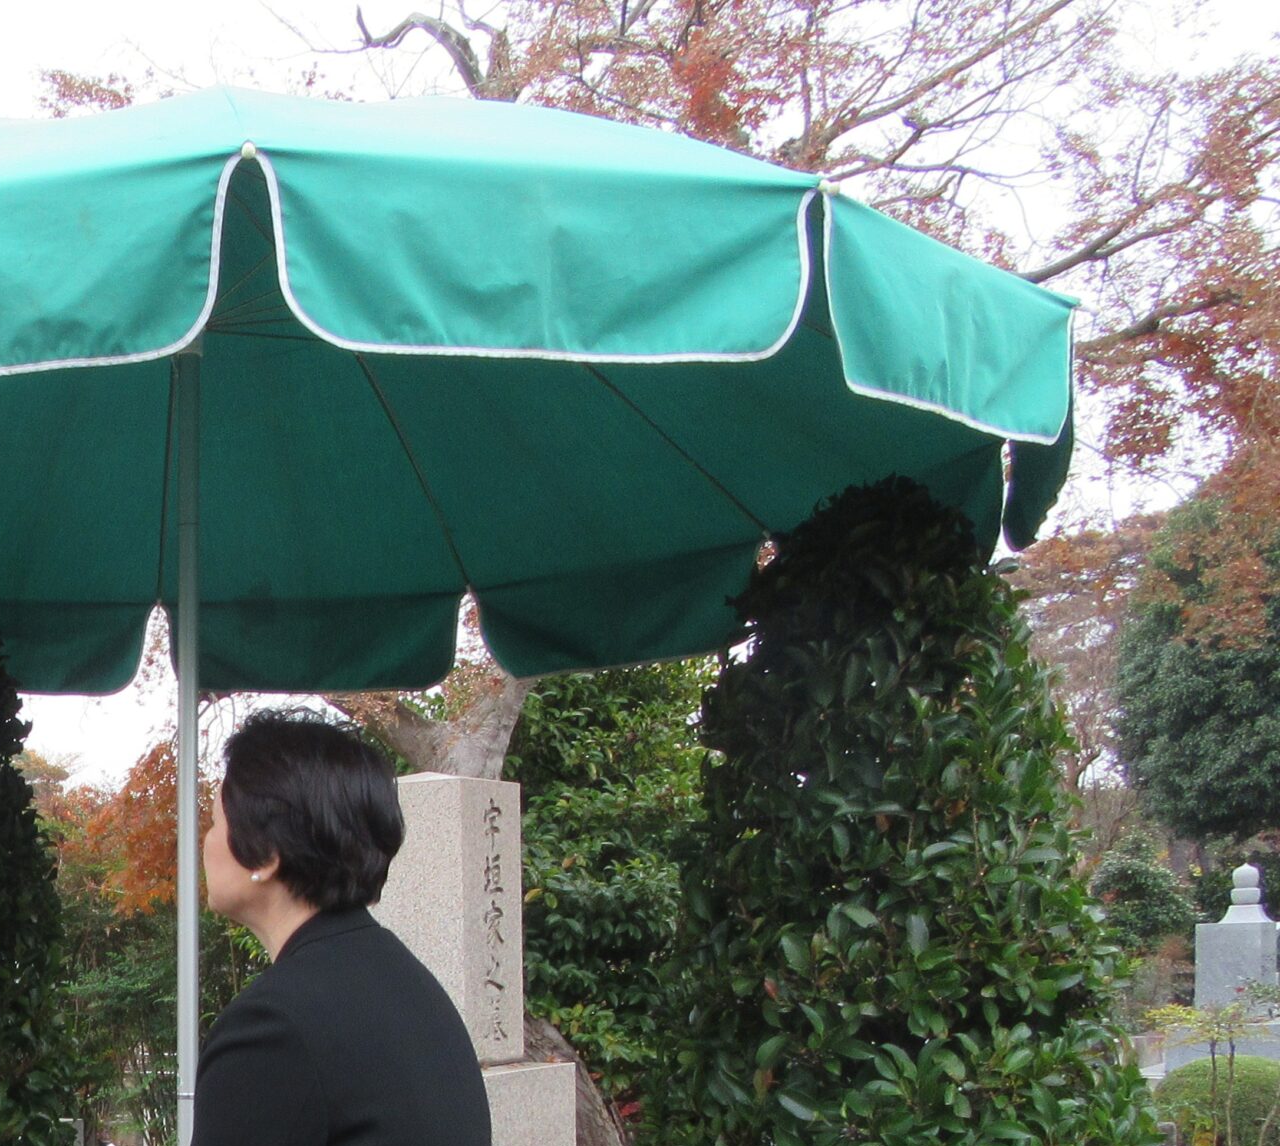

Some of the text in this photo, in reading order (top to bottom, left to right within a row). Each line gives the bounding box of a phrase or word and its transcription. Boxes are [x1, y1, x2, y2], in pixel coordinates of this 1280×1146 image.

[483, 798, 508, 1042] 宇垣家之墓
